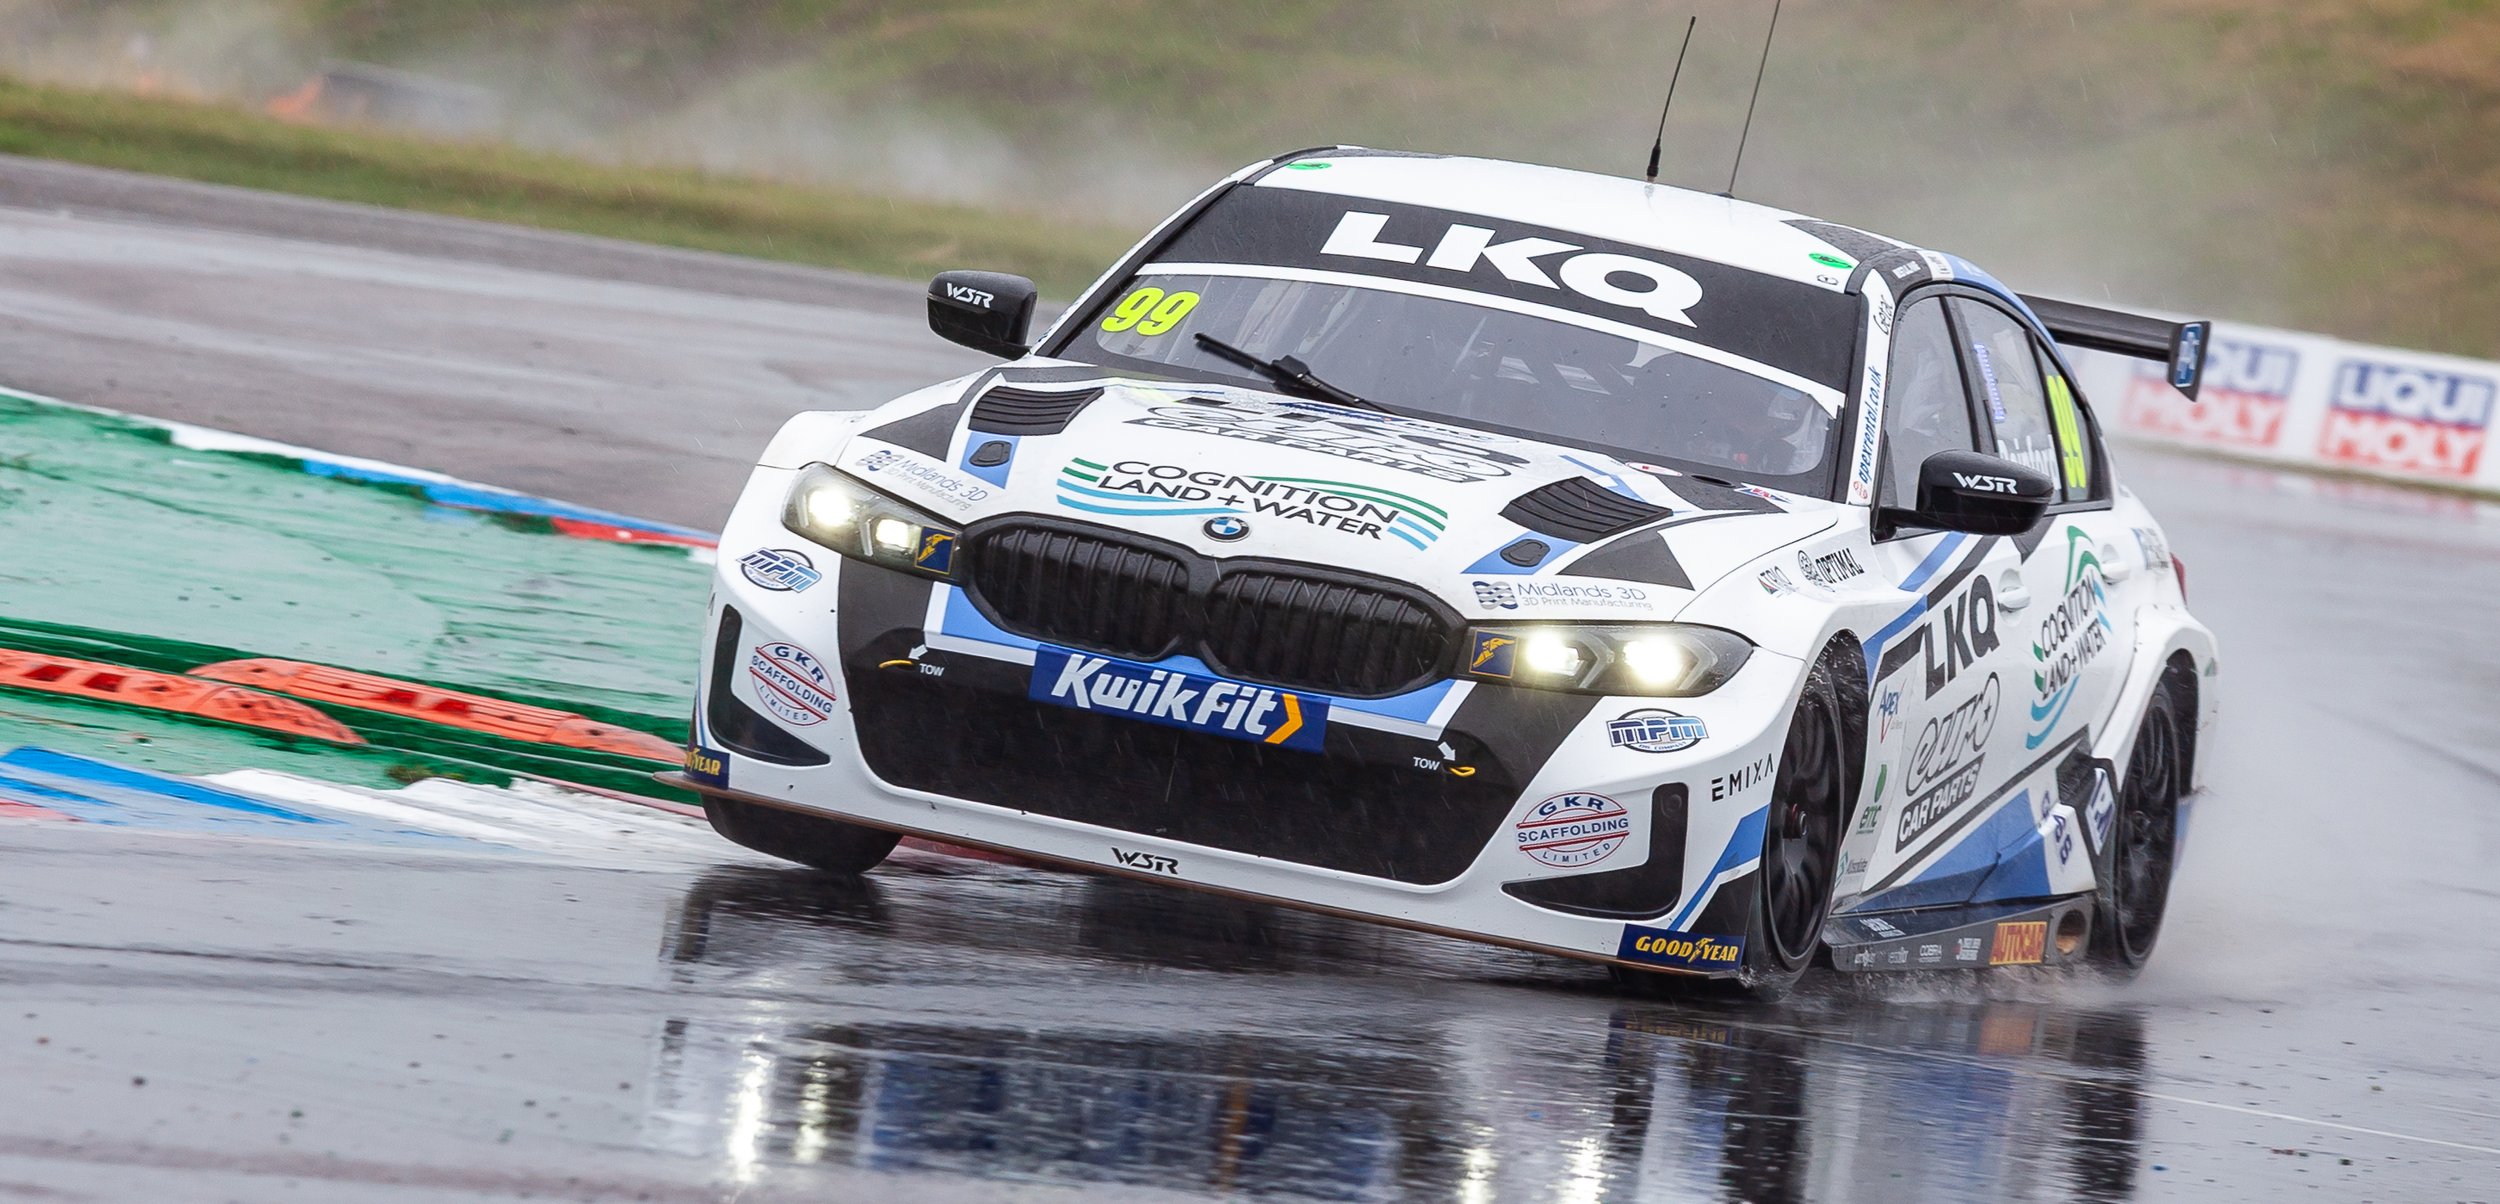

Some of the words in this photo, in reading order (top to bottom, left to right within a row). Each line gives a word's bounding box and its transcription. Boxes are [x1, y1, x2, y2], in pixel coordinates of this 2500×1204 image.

[1320, 211, 1703, 328] LKQ
[946, 282, 994, 308] WSR
[1101, 287, 1200, 336] 99
[1858, 366, 1882, 484] apexrental.co.uk
[1143, 418, 1268, 440] CAR
[1275, 437, 1468, 482] PARTS
[900, 460, 963, 492] Midlands
[960, 485, 988, 502] 3D
[1112, 461, 1399, 524] COGNITION
[1952, 472, 2017, 494] WSR
[1098, 476, 1211, 502] LAND
[1217, 494, 1245, 506] +
[1253, 497, 1382, 540] WATER
[1815, 548, 1865, 584] OPTIMAL
[1517, 583, 1612, 598] Midlands
[1616, 586, 1647, 600] 3D
[1542, 597, 1567, 607] Print
[1571, 598, 1654, 611] Manufacturing
[2041, 571, 2099, 659] COGNITION
[1925, 574, 2000, 700] LKQ
[774, 645, 825, 683] GKR
[919, 663, 945, 676] TOW
[2042, 658, 2071, 701] LAND
[2077, 617, 2107, 667] WATER
[751, 655, 833, 714] SCAFFOLDING
[759, 684, 809, 721] LIMITED
[1905, 671, 2000, 796] euro
[1413, 756, 1440, 770] TOW
[1711, 753, 1773, 802] EMIXA
[1539, 796, 1604, 816] GKR
[1899, 792, 1930, 843] CAR
[1930, 762, 1980, 820] PARTS
[1518, 818, 1629, 842] SCAFFOLDING
[1111, 847, 1179, 875] WSR
[1543, 843, 1610, 862] LIMITED
